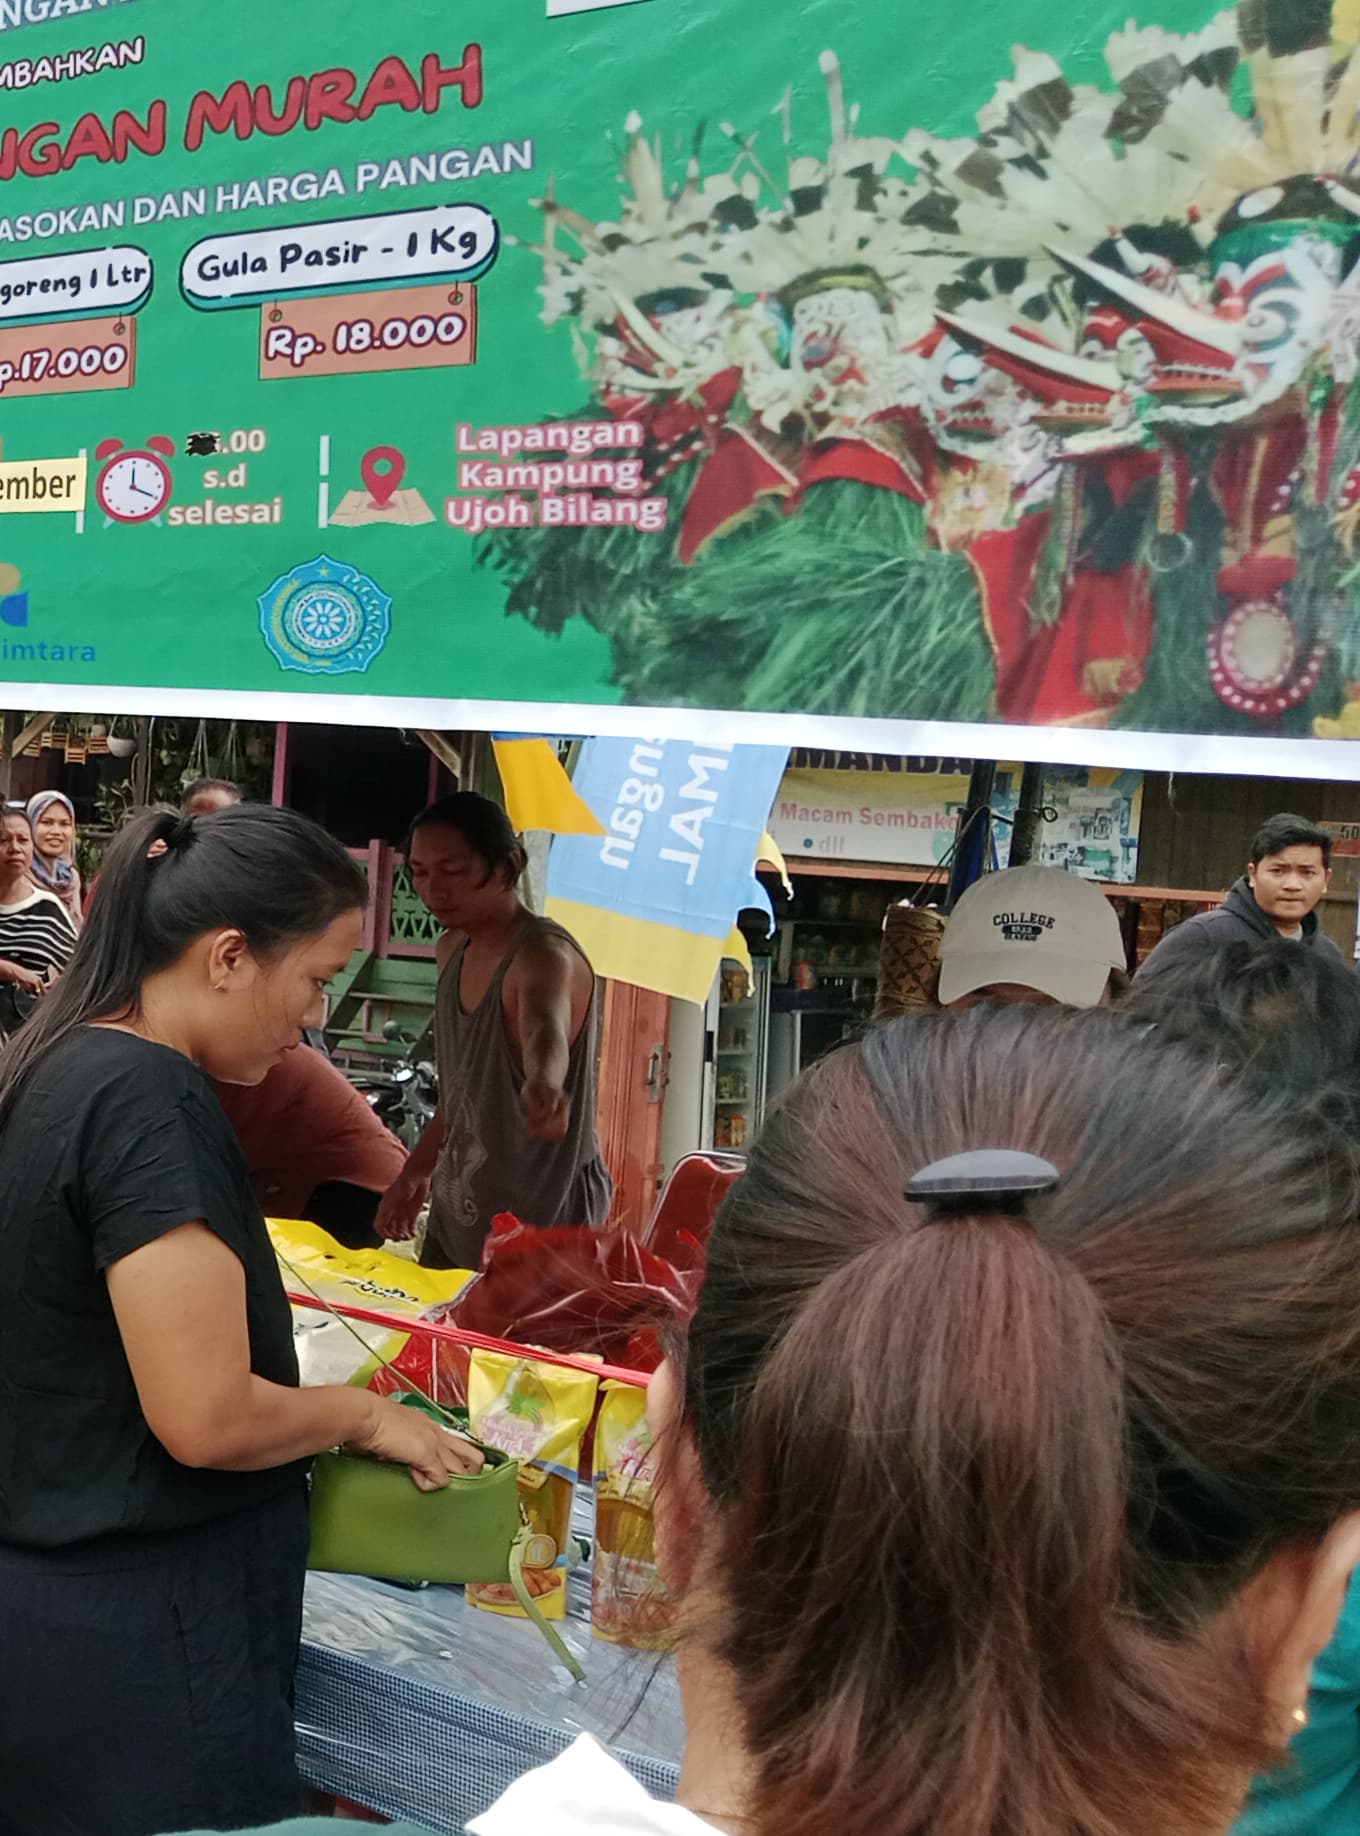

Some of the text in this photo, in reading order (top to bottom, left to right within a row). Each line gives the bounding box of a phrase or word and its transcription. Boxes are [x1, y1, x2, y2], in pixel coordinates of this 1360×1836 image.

[183, 42, 483, 151] MURAH
[133, 188, 206, 227] DAN
[216, 168, 346, 214] HARGA
[356, 139, 534, 193] PANGAN
[196, 252, 268, 282] Gula
[279, 239, 370, 272] Pasir
[407, 231, 419, 258] 1
[430, 224, 479, 258] Kg
[0, 272, 82, 306] goreng
[89, 267, 98, 289] 1
[107, 261, 148, 288] Ltr
[264, 312, 467, 367] Rp. 18.000
[458, 422, 643, 457] Lapangan
[202, 463, 248, 490] s.d
[459, 459, 643, 493] Kampung
[167, 497, 283, 526] selesai
[446, 499, 529, 532] Ujoh
[541, 496, 665, 530] Bilang
[780, 802, 854, 825] Macam
[819, 834, 846, 854] dll
[993, 912, 1057, 929] COLLEGE
